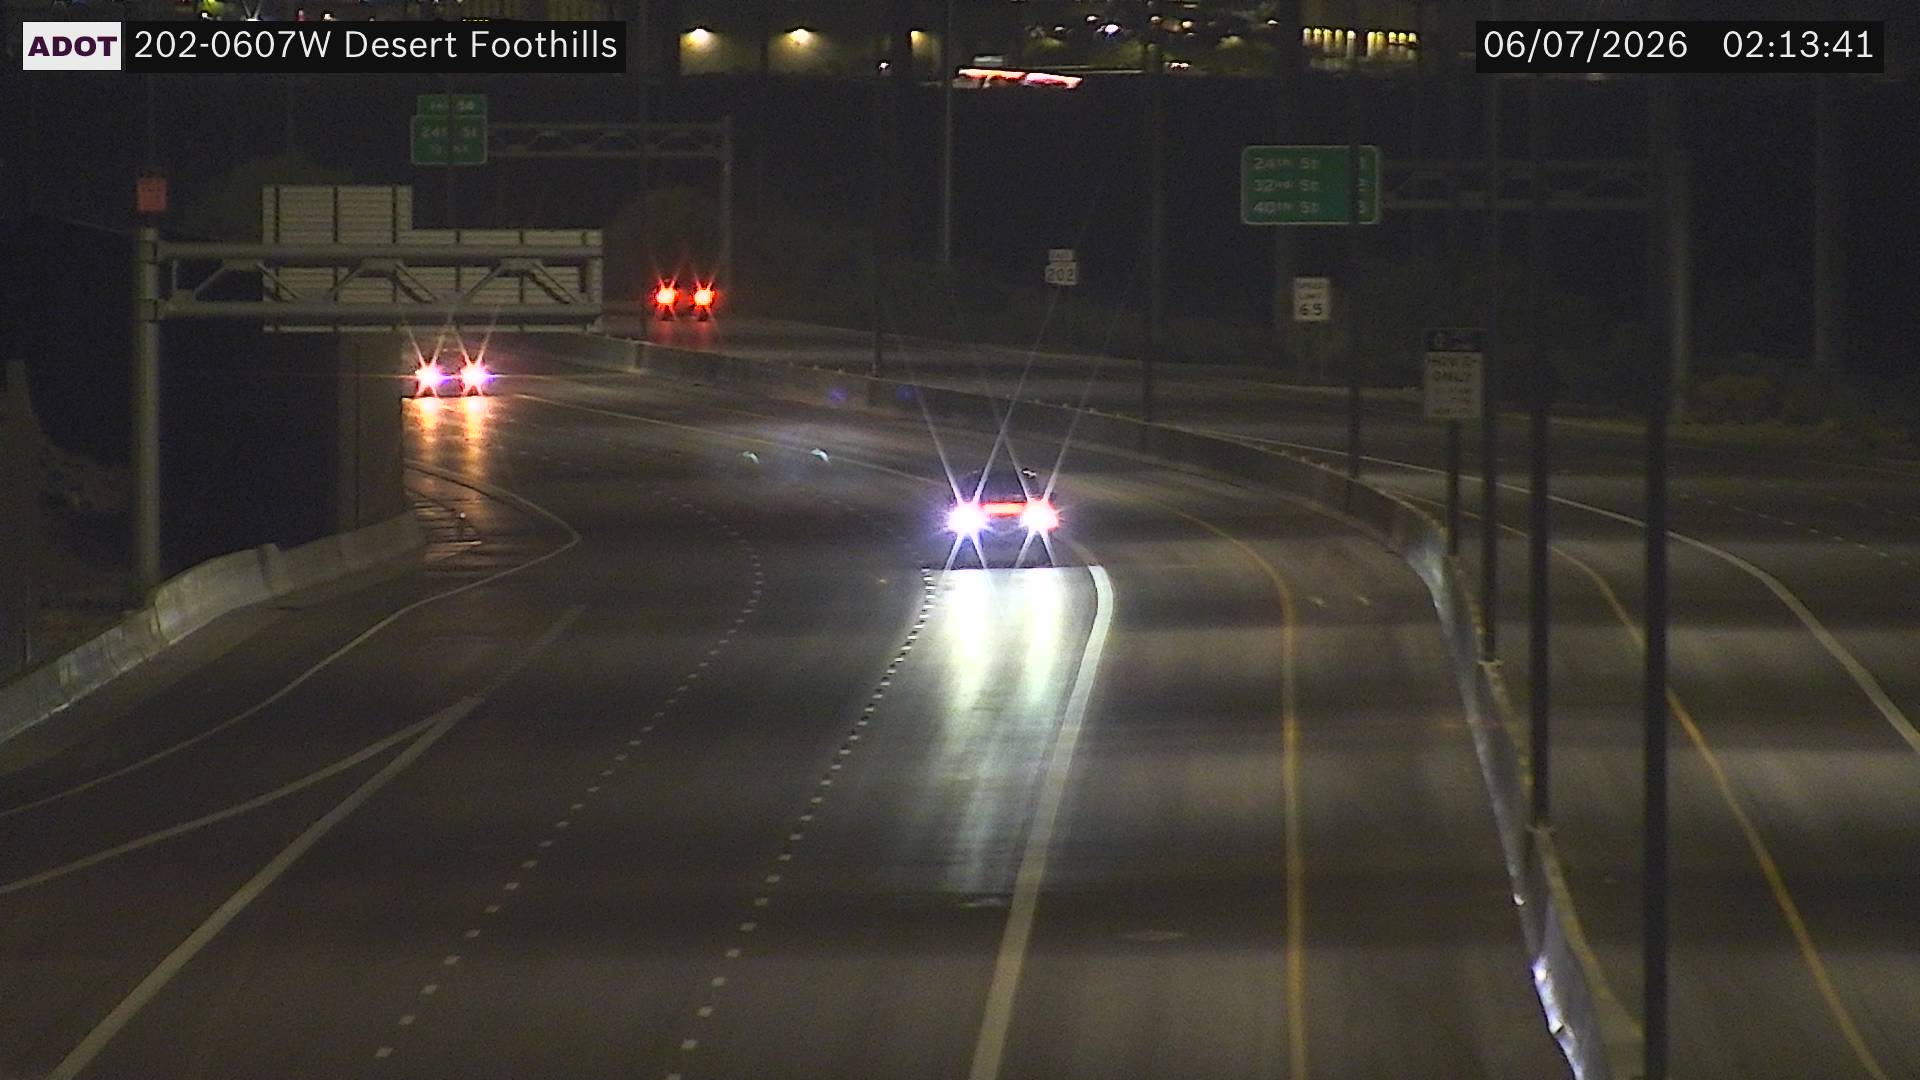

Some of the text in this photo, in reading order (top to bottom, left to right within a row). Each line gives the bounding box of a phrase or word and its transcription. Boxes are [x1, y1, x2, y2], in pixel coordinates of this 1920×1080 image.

[1253, 157, 1292, 170] 24th
[1299, 157, 1320, 170] St
[1253, 179, 1294, 192] 32nd
[1299, 179, 1320, 192] St
[1253, 201, 1293, 214] 40th
[1299, 201, 1320, 214] St
[1047, 267, 1074, 282] 202
[1299, 303, 1323, 316] 65
